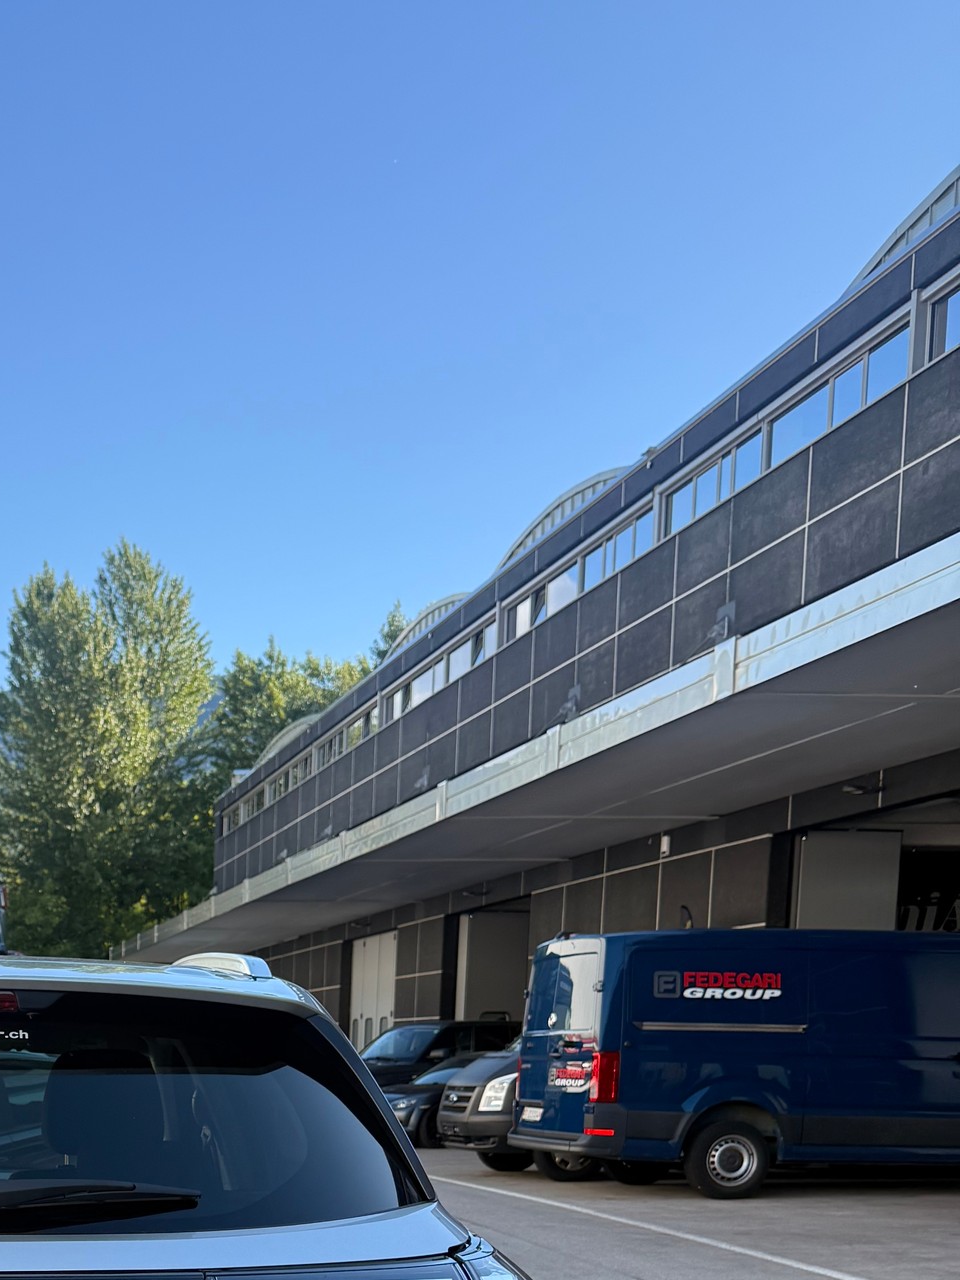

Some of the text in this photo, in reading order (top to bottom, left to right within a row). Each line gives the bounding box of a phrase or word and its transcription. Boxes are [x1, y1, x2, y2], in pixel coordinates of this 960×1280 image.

[683, 971, 782, 989] FEDEGARI
[683, 987, 782, 1000] GROUP
[555, 1078, 585, 1087] GROUP
